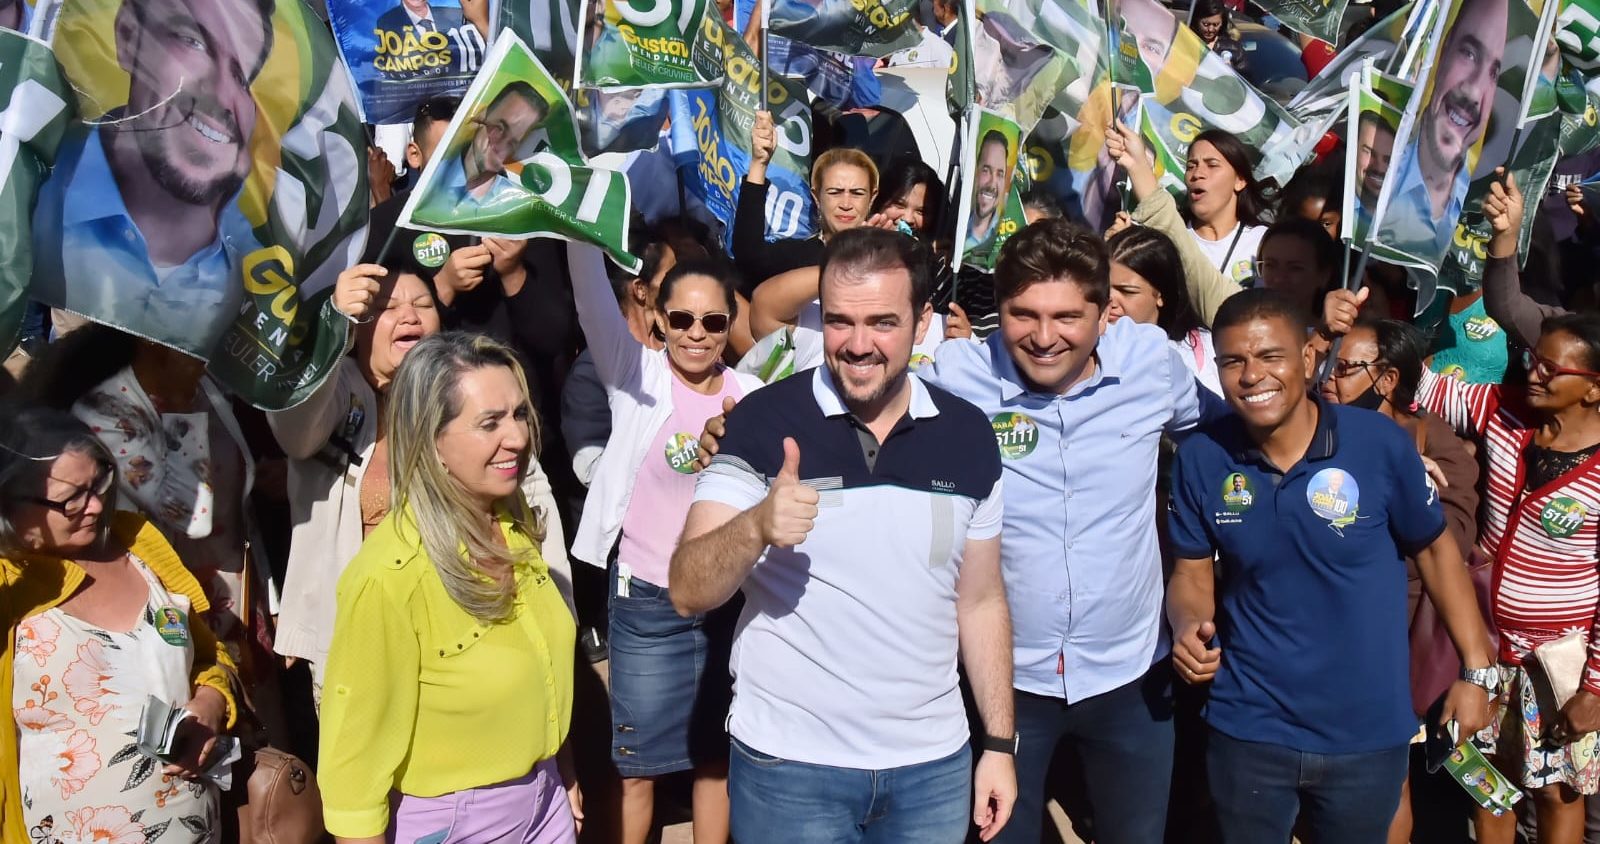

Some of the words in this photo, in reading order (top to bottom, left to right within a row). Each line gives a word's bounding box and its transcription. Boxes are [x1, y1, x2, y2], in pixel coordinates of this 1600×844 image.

[373, 25, 449, 56] JOÃO
[618, 24, 689, 57] Gustav
[373, 49, 452, 72] CAMPOS
[658, 62, 694, 82] CRUVINEL
[692, 97, 737, 192] JOÃO
[417, 243, 446, 260] 51111
[995, 429, 1034, 446] 51111
[931, 479, 955, 489] SALLO
[1241, 495, 1252, 505] 51
[1543, 508, 1580, 530] 51111
